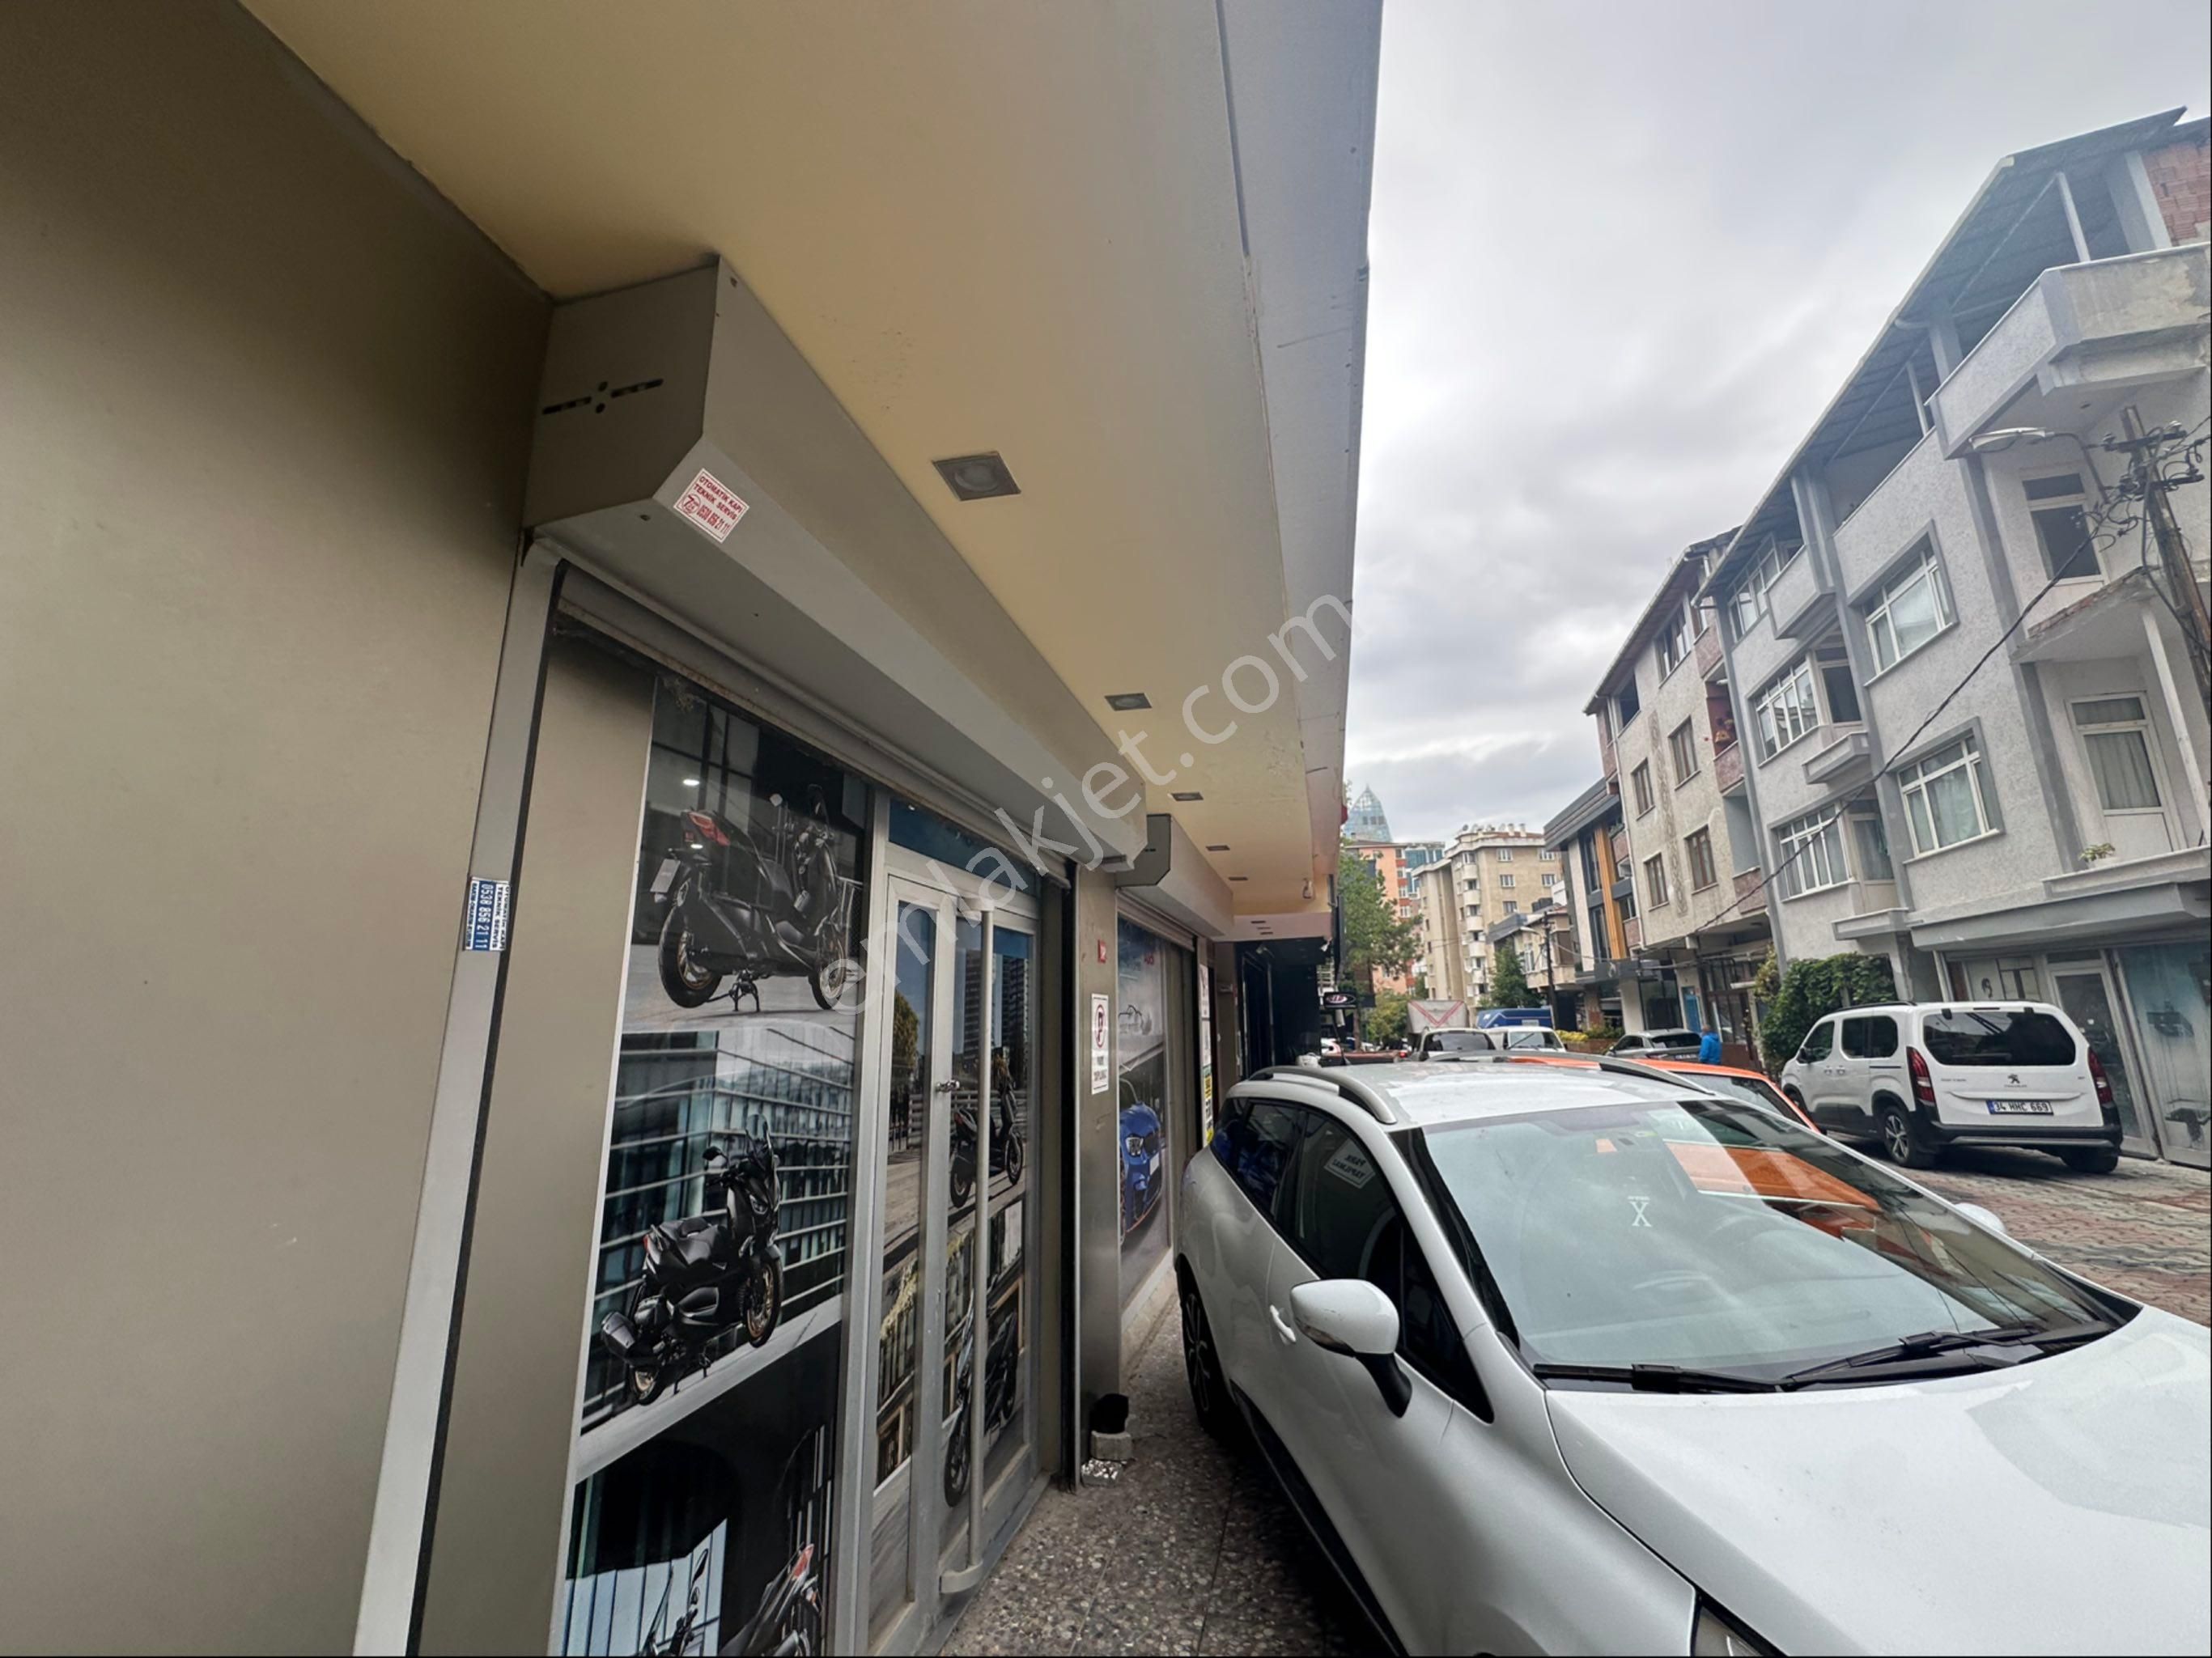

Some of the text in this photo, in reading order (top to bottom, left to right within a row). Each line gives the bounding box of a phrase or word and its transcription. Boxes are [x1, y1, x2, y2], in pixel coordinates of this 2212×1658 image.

[475, 884, 494, 948] 0538 856 21 11
[1993, 1101, 2006, 1112] 34
[2031, 1101, 2049, 1112] 669
